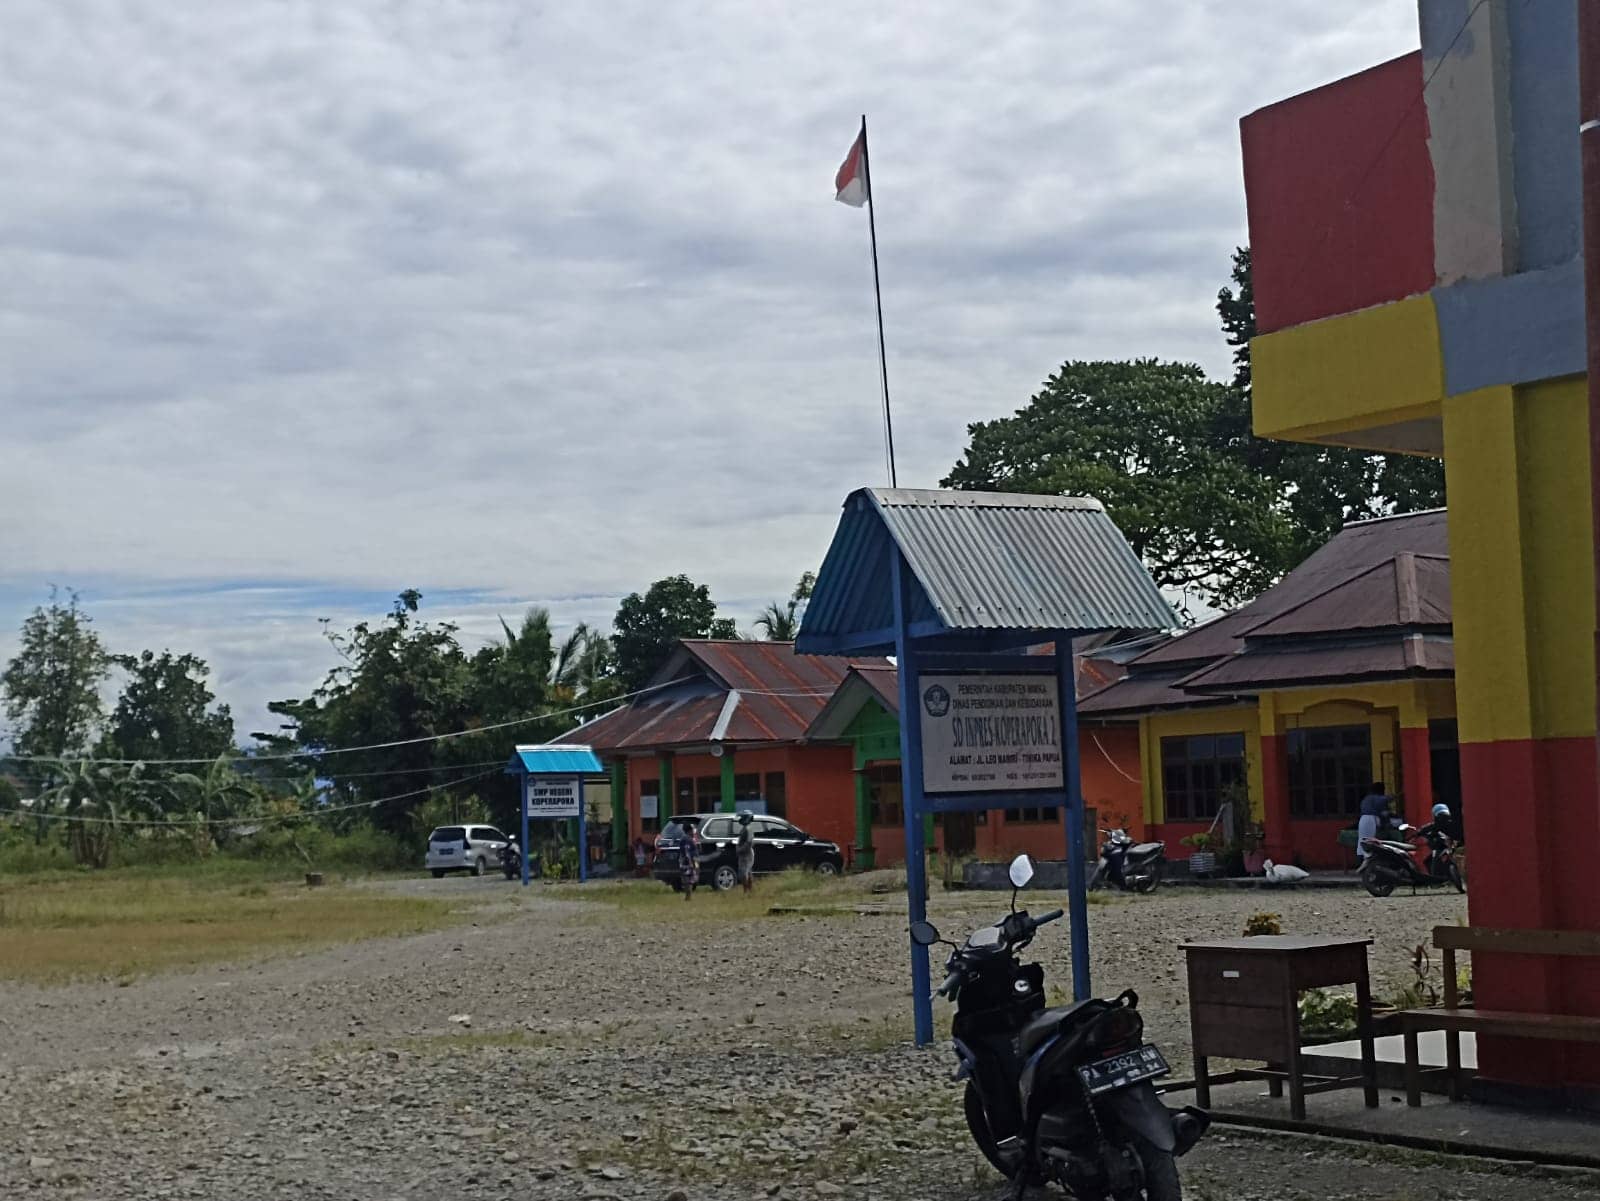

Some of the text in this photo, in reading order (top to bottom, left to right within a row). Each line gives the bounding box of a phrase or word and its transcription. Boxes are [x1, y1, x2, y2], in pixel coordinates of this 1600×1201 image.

[952, 716, 963, 747] SD
[965, 716, 993, 747] INPRES
[994, 715, 1048, 746] KOPERAPOKA
[533, 788, 548, 797] SMP
